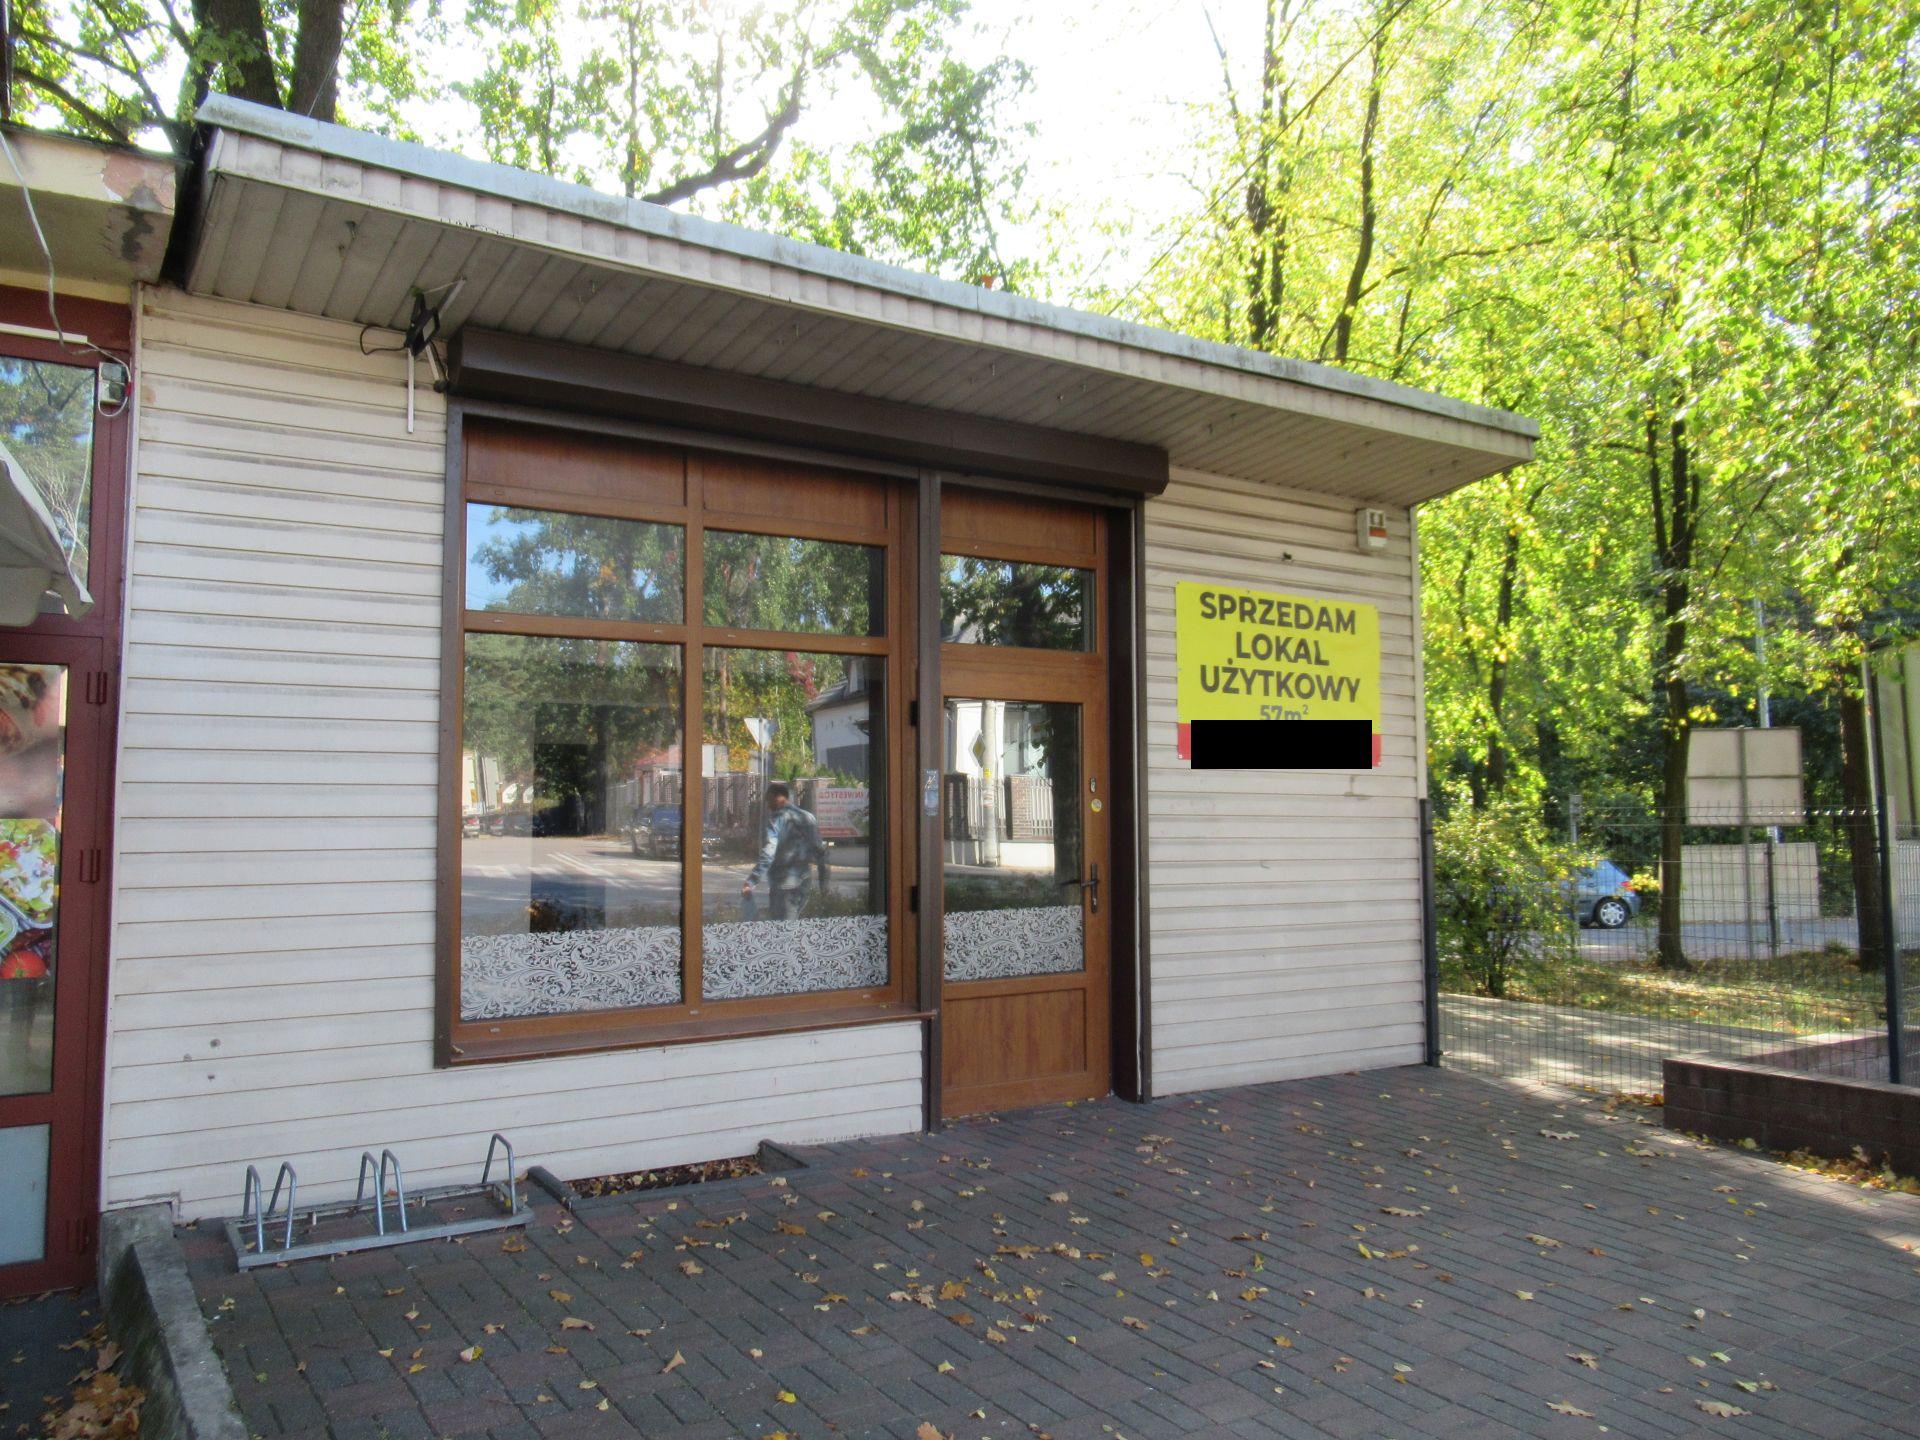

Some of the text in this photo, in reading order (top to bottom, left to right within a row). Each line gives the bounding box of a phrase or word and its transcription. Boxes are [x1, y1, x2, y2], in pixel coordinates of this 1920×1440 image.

[1200, 591, 1356, 635] SPRZEDAM
[1236, 631, 1330, 666] LOKAL
[1200, 658, 1361, 703] UŻYTKOWY
